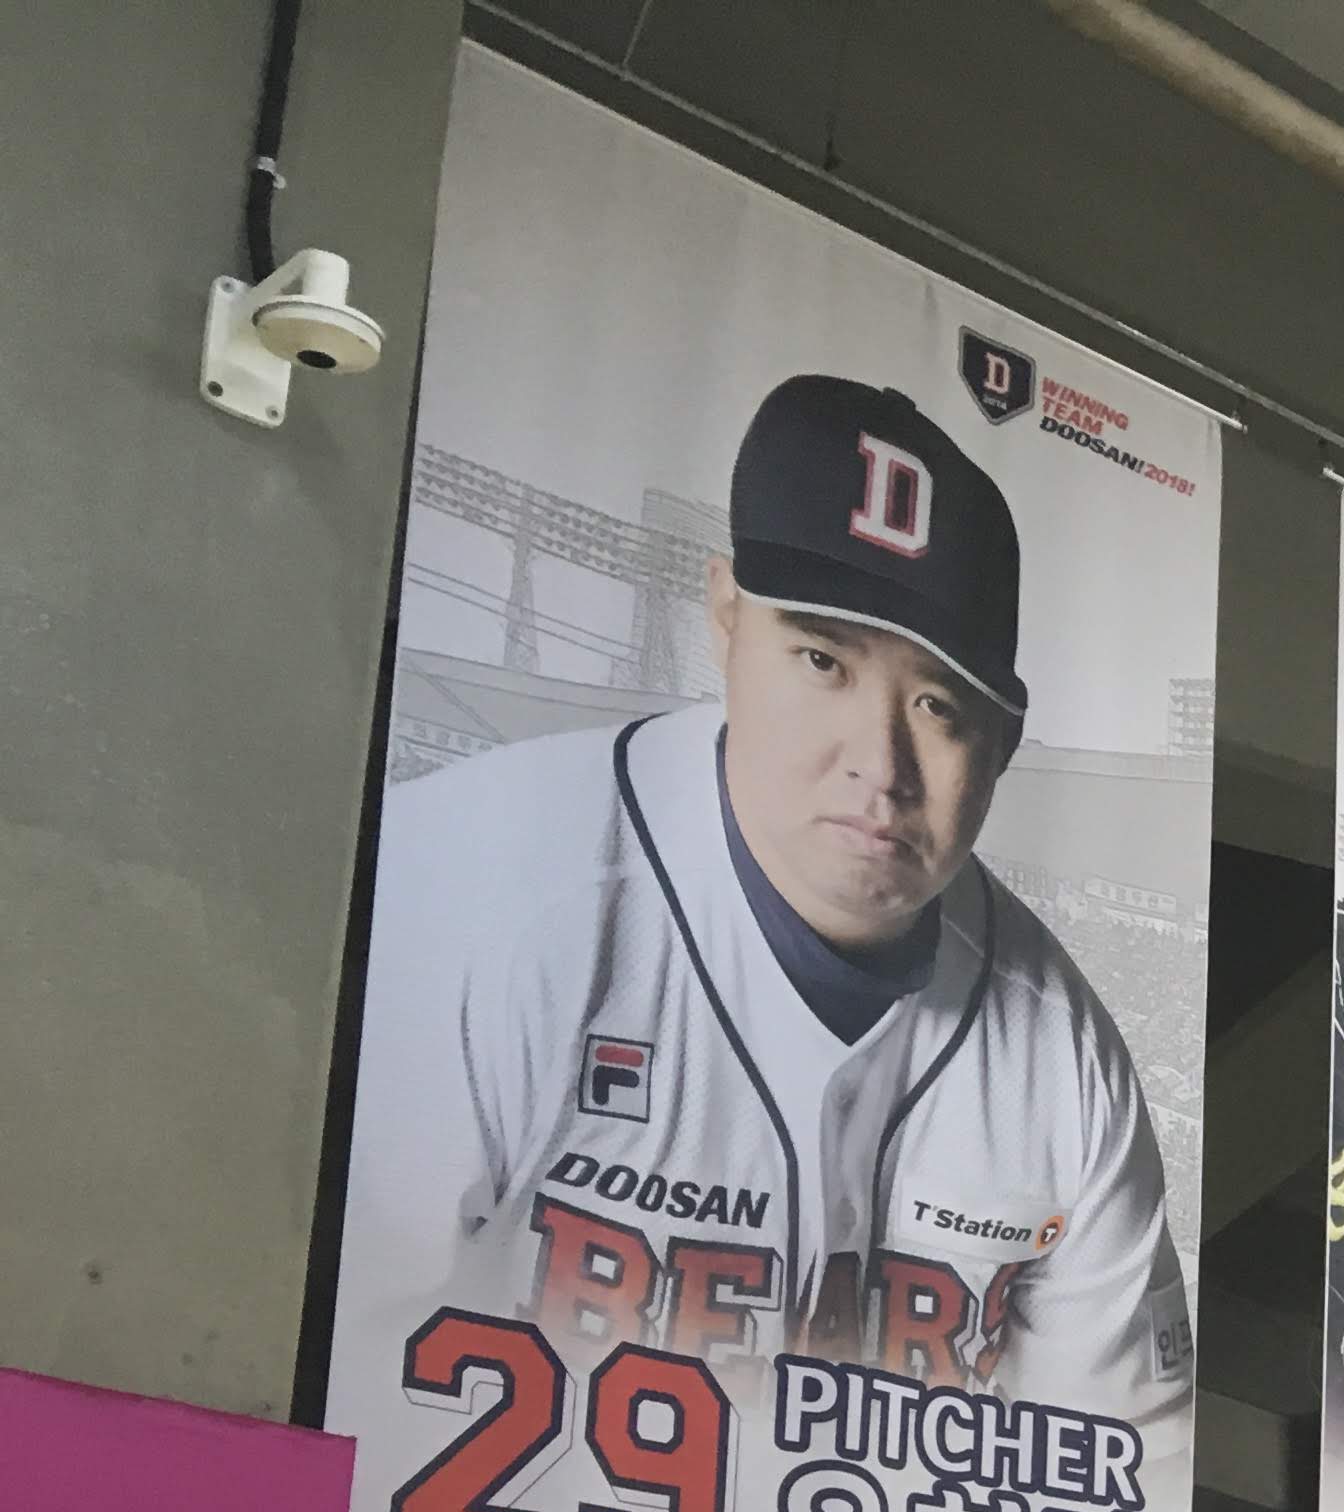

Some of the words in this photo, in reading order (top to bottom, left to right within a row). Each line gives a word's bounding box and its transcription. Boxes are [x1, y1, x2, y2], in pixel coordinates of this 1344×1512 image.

[1041, 376, 1130, 431] WINNING
[1042, 396, 1105, 435] TEAM
[1144, 463, 1196, 497] 2018!
[544, 1152, 770, 1230] DOOSAN
[773, 1353, 1144, 1511] PITCHER
